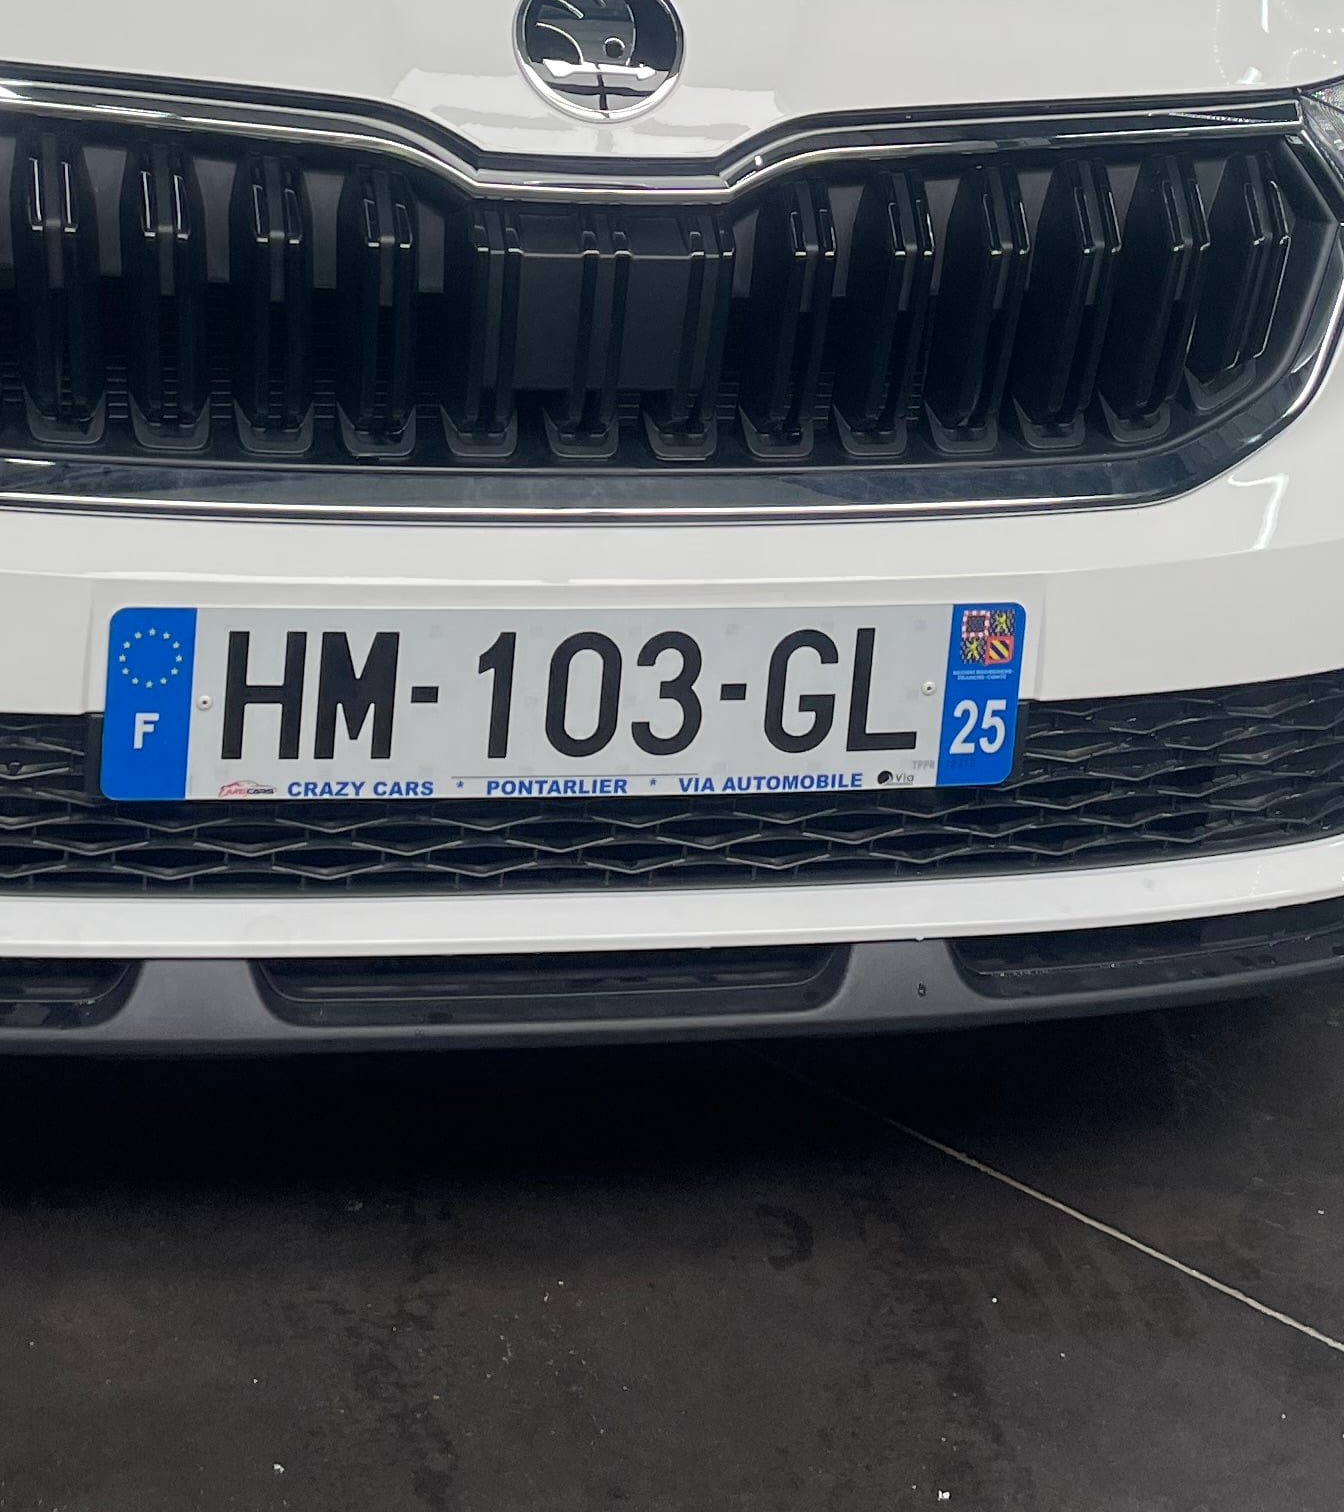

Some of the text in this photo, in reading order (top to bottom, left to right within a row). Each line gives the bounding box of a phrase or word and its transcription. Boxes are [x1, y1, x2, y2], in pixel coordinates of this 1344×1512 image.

[221, 627, 918, 759] HM-103-GL
[133, 712, 160, 749] F
[949, 699, 1007, 755] 25
[287, 773, 864, 797] CRAZY CARS PONTARLIER VIA AUTOMOBILE
